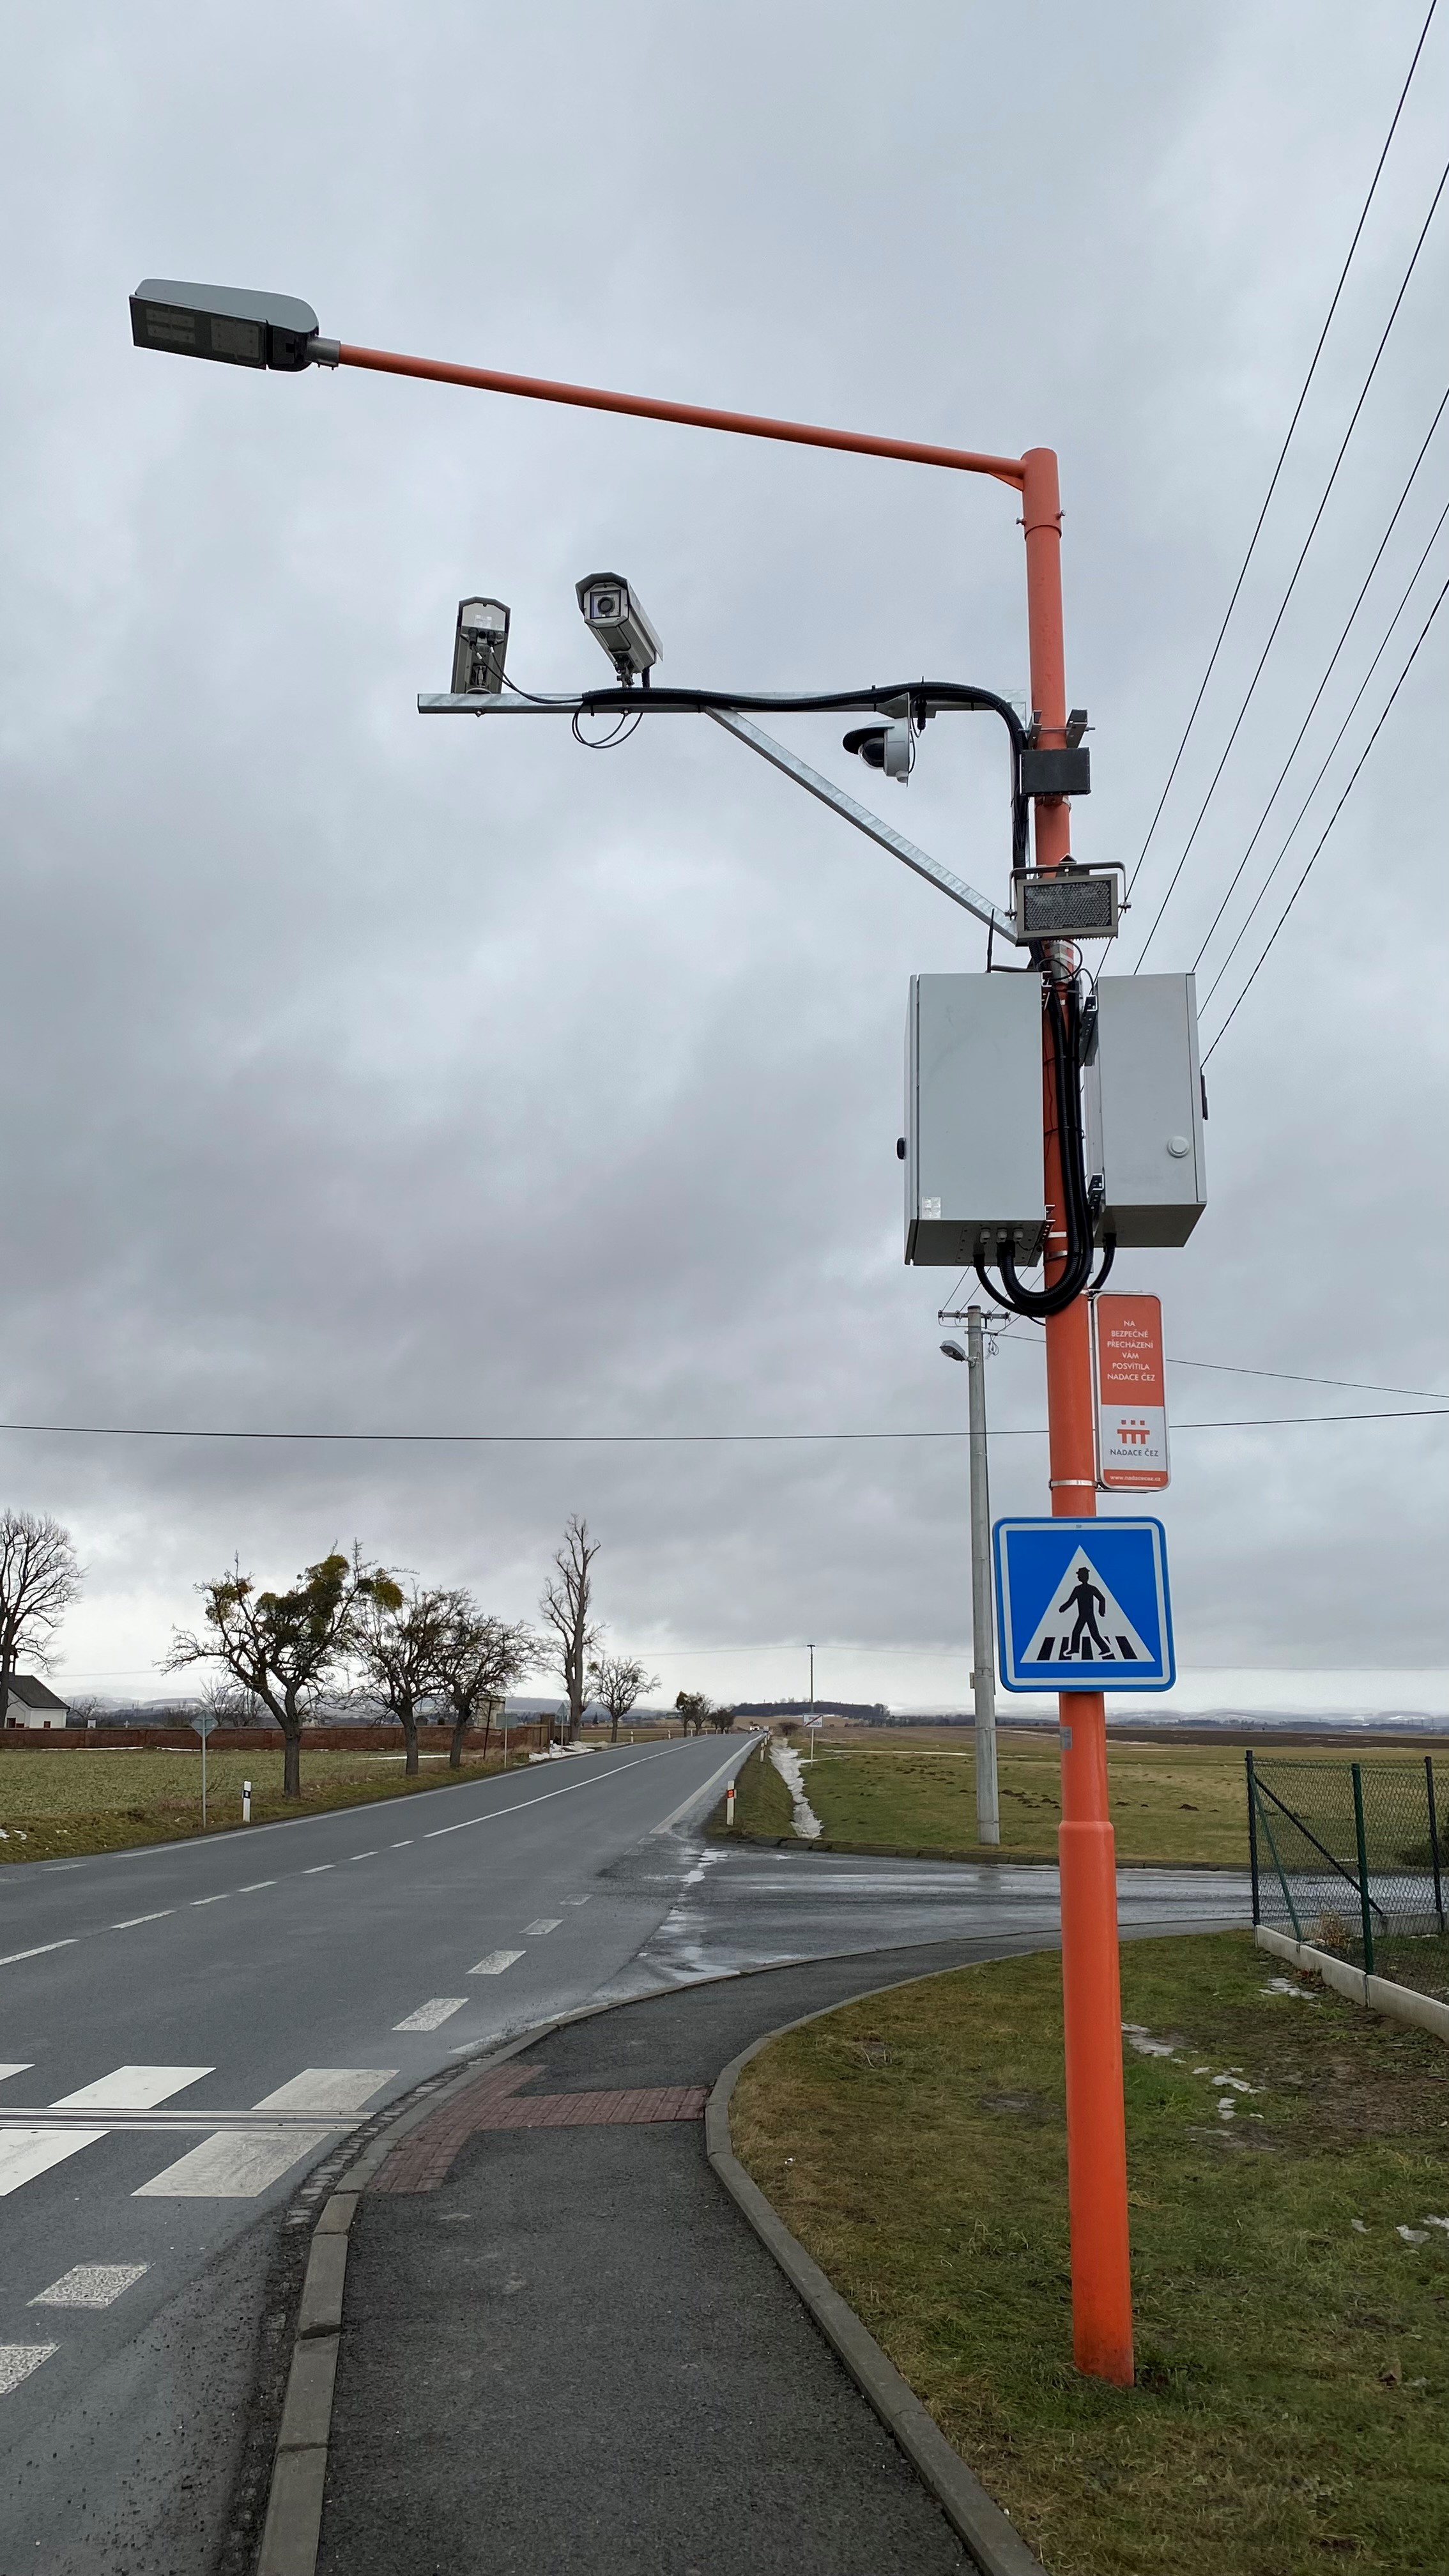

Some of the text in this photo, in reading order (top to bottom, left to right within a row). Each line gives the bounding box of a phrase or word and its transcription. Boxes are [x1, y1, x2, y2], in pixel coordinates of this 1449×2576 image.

[1111, 1329, 1149, 1338] BEZPEČNÉ
[1107, 1339, 1153, 1349] PŘECHÁZENÍ
[1122, 1350, 1139, 1359] VÁM
[1141, 1372, 1156, 1381] ČEZ
[1144, 1448, 1158, 1457] ČEZ
